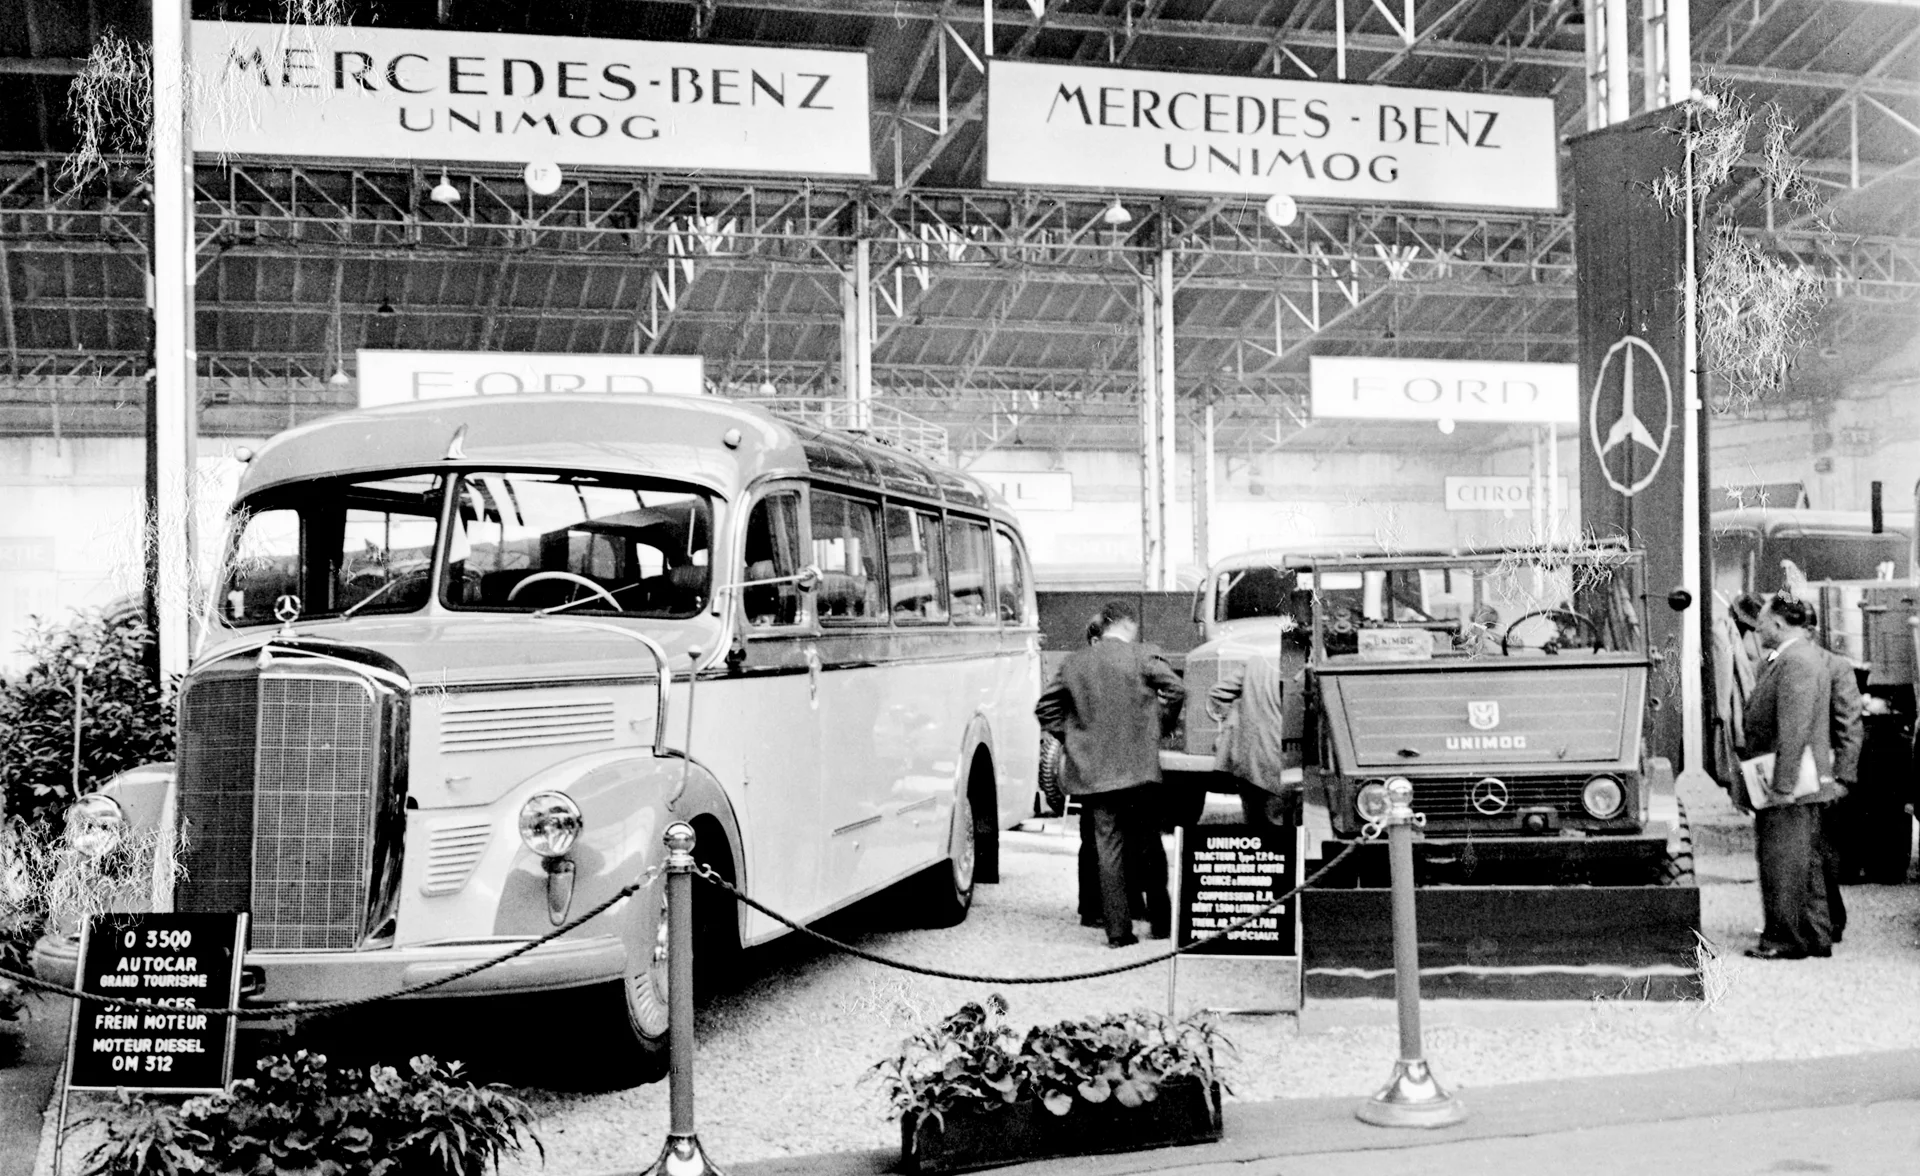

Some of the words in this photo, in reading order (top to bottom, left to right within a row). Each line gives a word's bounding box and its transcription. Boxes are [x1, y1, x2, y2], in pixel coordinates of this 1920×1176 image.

[222, 45, 834, 110] MERCEDES-BENZ
[399, 106, 660, 141] UNIMOG
[1164, 143, 1399, 184] UNIMOG
[411, 371, 656, 400] FORD
[1352, 377, 1541, 405] FORD
[1445, 735, 1527, 750] UNIMOG
[1206, 836, 1262, 850] UNIMOG
[145, 930, 193, 950] 3500
[1227, 928, 1279, 940] SPÉCIAUX
[116, 956, 198, 972] AUTOCAR
[99, 974, 140, 988] GRAND
[143, 974, 208, 988] TOURISME
[95, 1014, 139, 1030] FREIN
[143, 1014, 208, 1030] MOTEUR
[92, 1038, 152, 1053] MOTEUR
[154, 1038, 206, 1053] DIESEL
[112, 1055, 140, 1072] OM
[145, 1055, 174, 1072] 312
